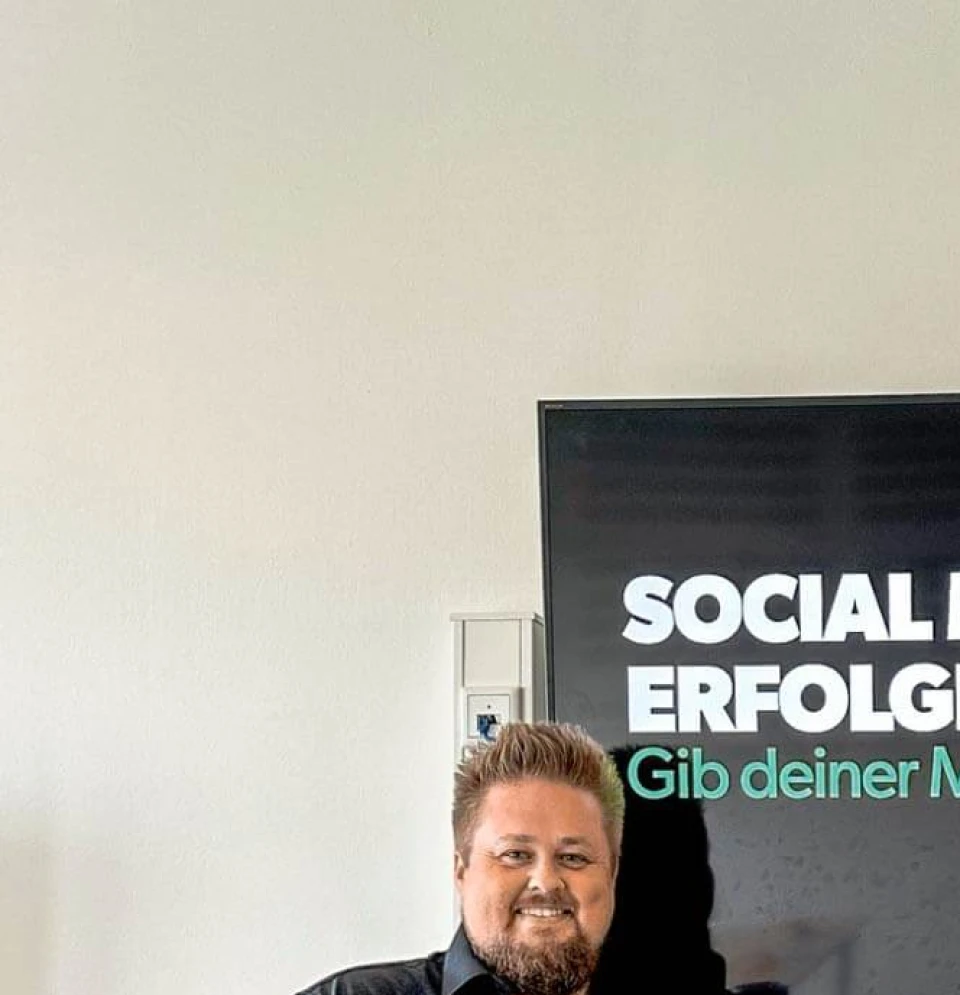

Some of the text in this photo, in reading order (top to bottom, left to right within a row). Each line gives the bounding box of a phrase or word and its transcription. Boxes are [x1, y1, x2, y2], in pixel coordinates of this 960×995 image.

[622, 572, 934, 645] SOCIAL
[627, 747, 730, 800] Gib
[740, 746, 920, 800] deiner
